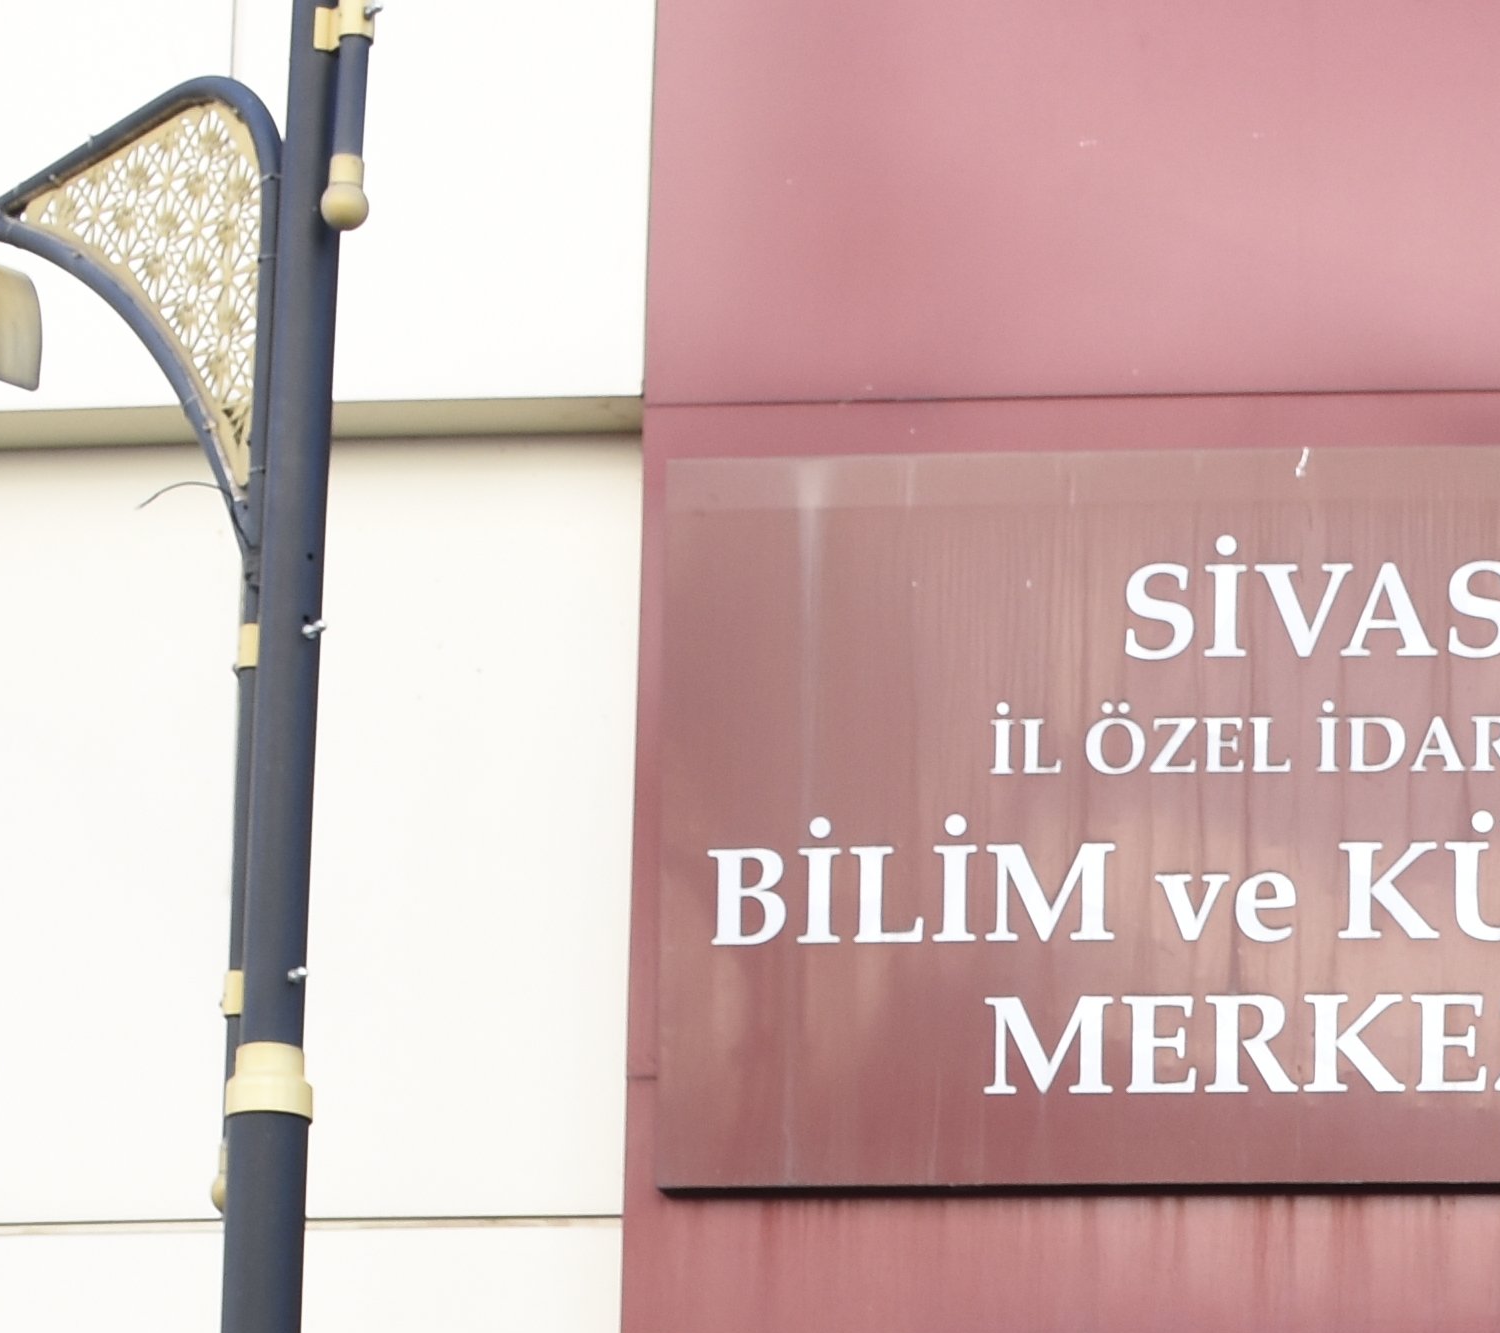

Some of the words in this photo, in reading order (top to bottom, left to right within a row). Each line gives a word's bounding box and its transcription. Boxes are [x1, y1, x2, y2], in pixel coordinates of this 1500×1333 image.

[990, 701, 1062, 775] İL
[1084, 701, 1292, 776] ÖZEL
[706, 813, 1117, 946] BİLİM
[1153, 868, 1298, 943] ve
